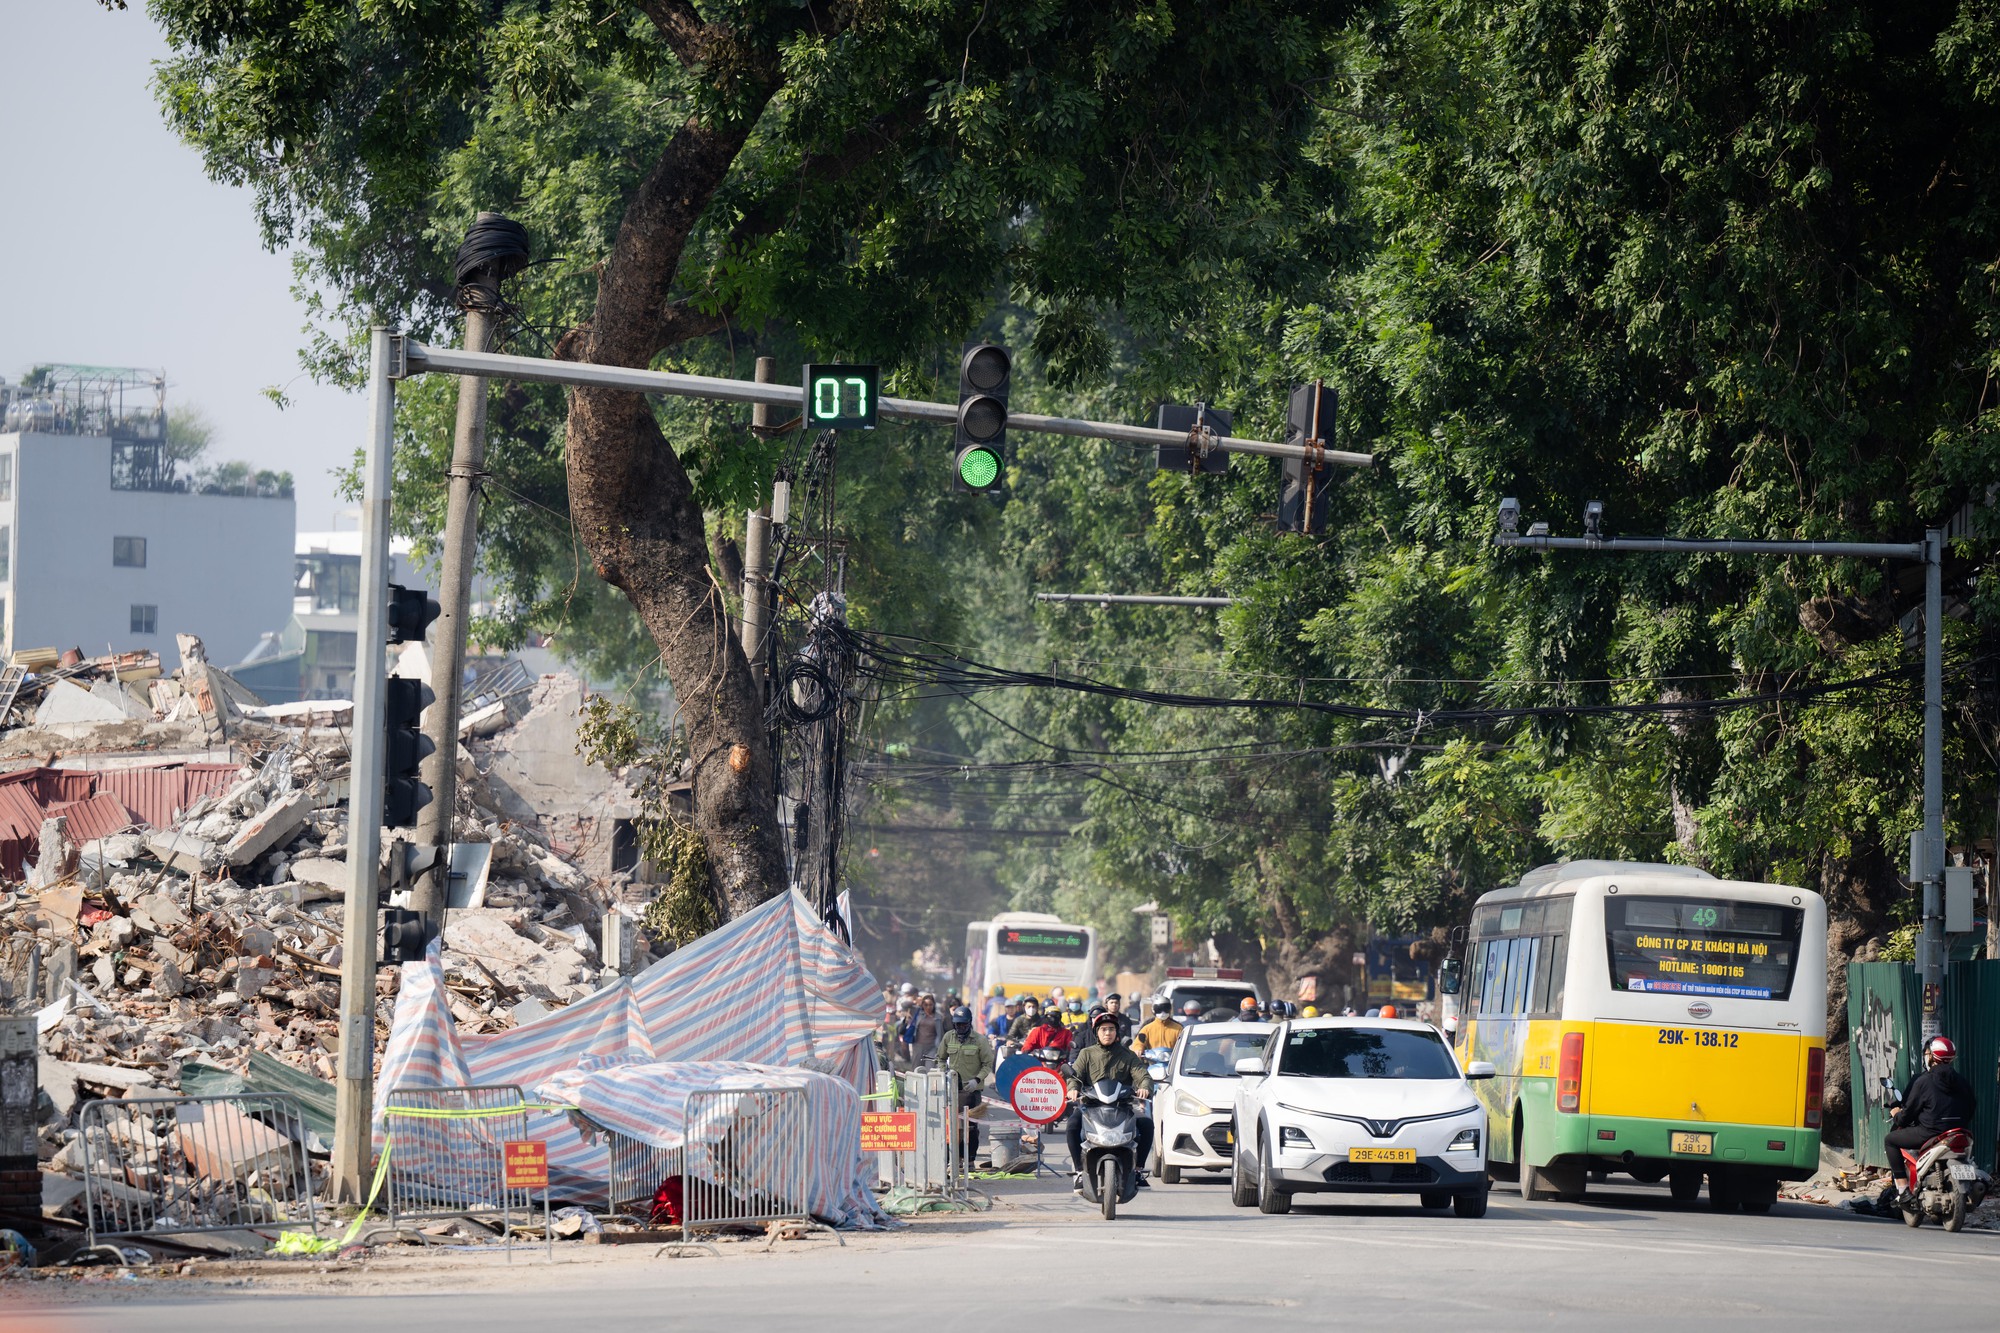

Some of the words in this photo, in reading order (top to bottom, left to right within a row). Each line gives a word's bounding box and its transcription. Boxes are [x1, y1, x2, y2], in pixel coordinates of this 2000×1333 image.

[816, 378, 866, 418] 07
[1692, 907, 1716, 927] 49
[1637, 935, 1661, 948] CÔNG
[1664, 938, 1674, 949] TY
[1676, 938, 1689, 950] CP
[1691, 940, 1702, 951] XE
[1705, 940, 1735, 953] KHÁCH
[1737, 942, 1749, 954] HÀ
[1752, 943, 1768, 957] NỘI
[1659, 961, 1698, 973] HOTLINE:
[1702, 964, 1744, 977] 19001165
[1658, 1029, 1689, 1044] 29K-
[1694, 1031, 1739, 1048] 138.12
[1678, 1143, 1707, 1153] 138.12
[1684, 1134, 1700, 1143] 29K
